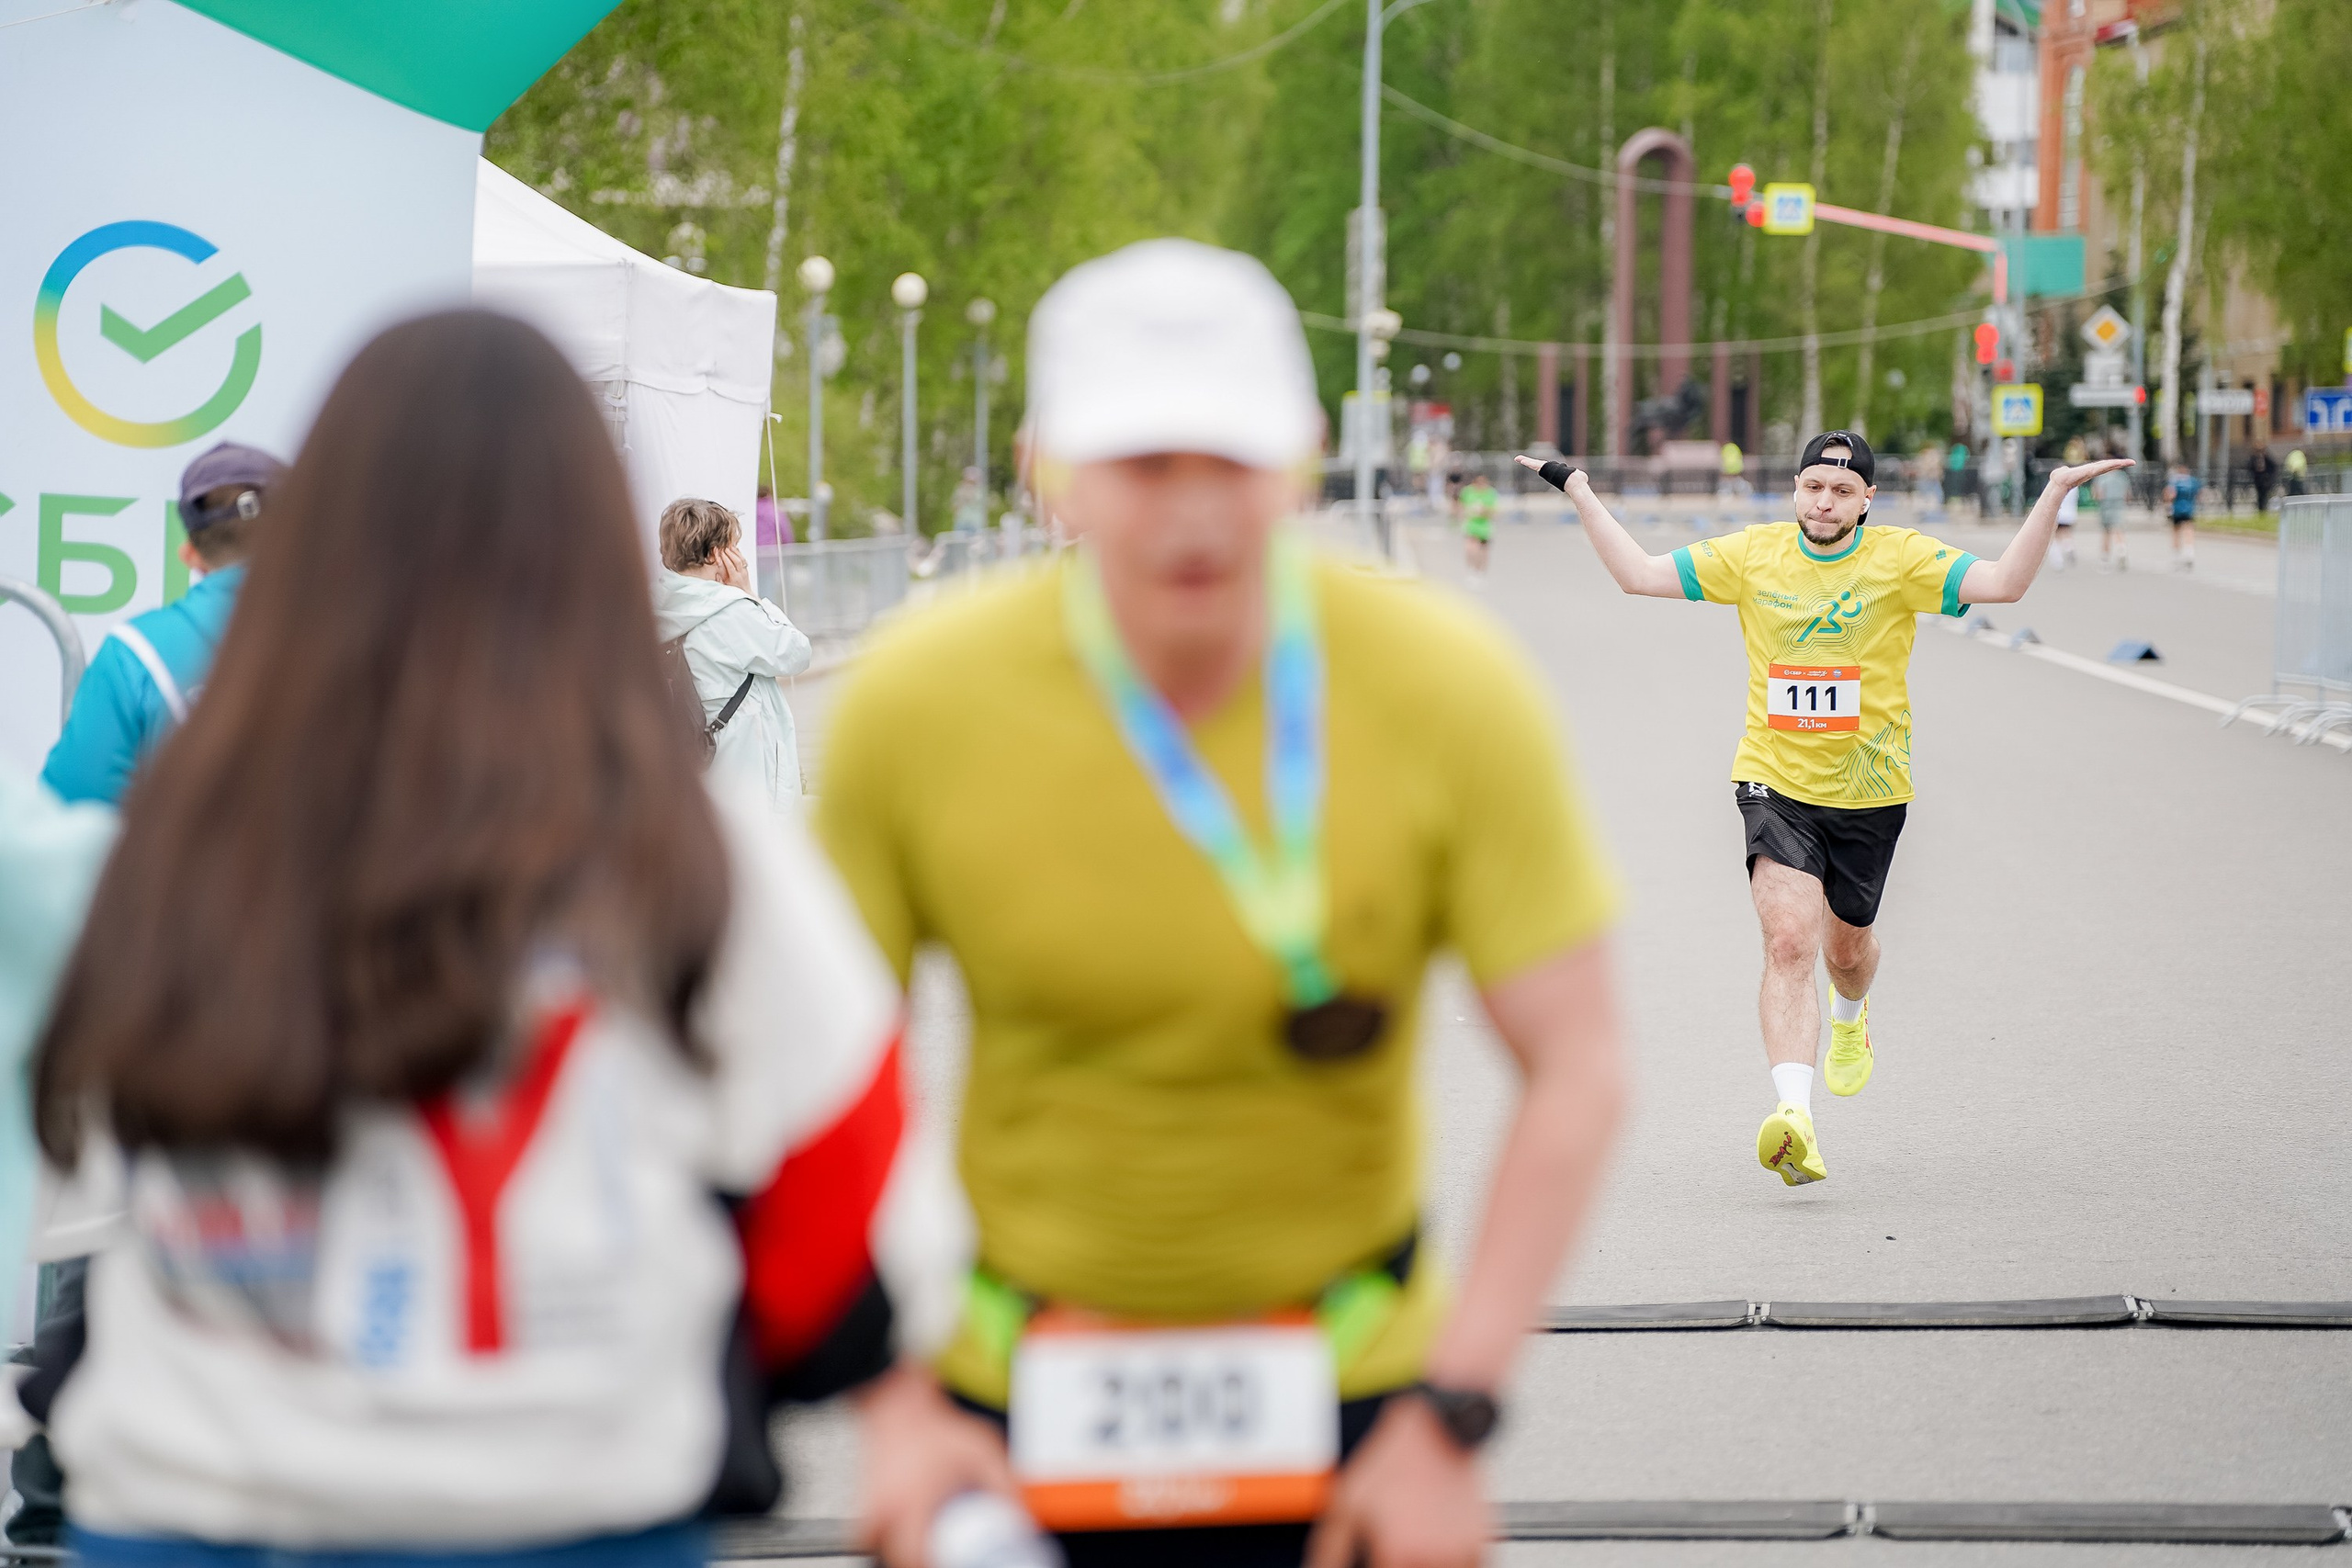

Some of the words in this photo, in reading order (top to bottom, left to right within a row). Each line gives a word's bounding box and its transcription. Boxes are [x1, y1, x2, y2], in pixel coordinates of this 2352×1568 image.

[1701, 541, 1713, 557] БЕР
[1757, 589, 1799, 602] зелёный
[1787, 685, 1837, 711] 111
